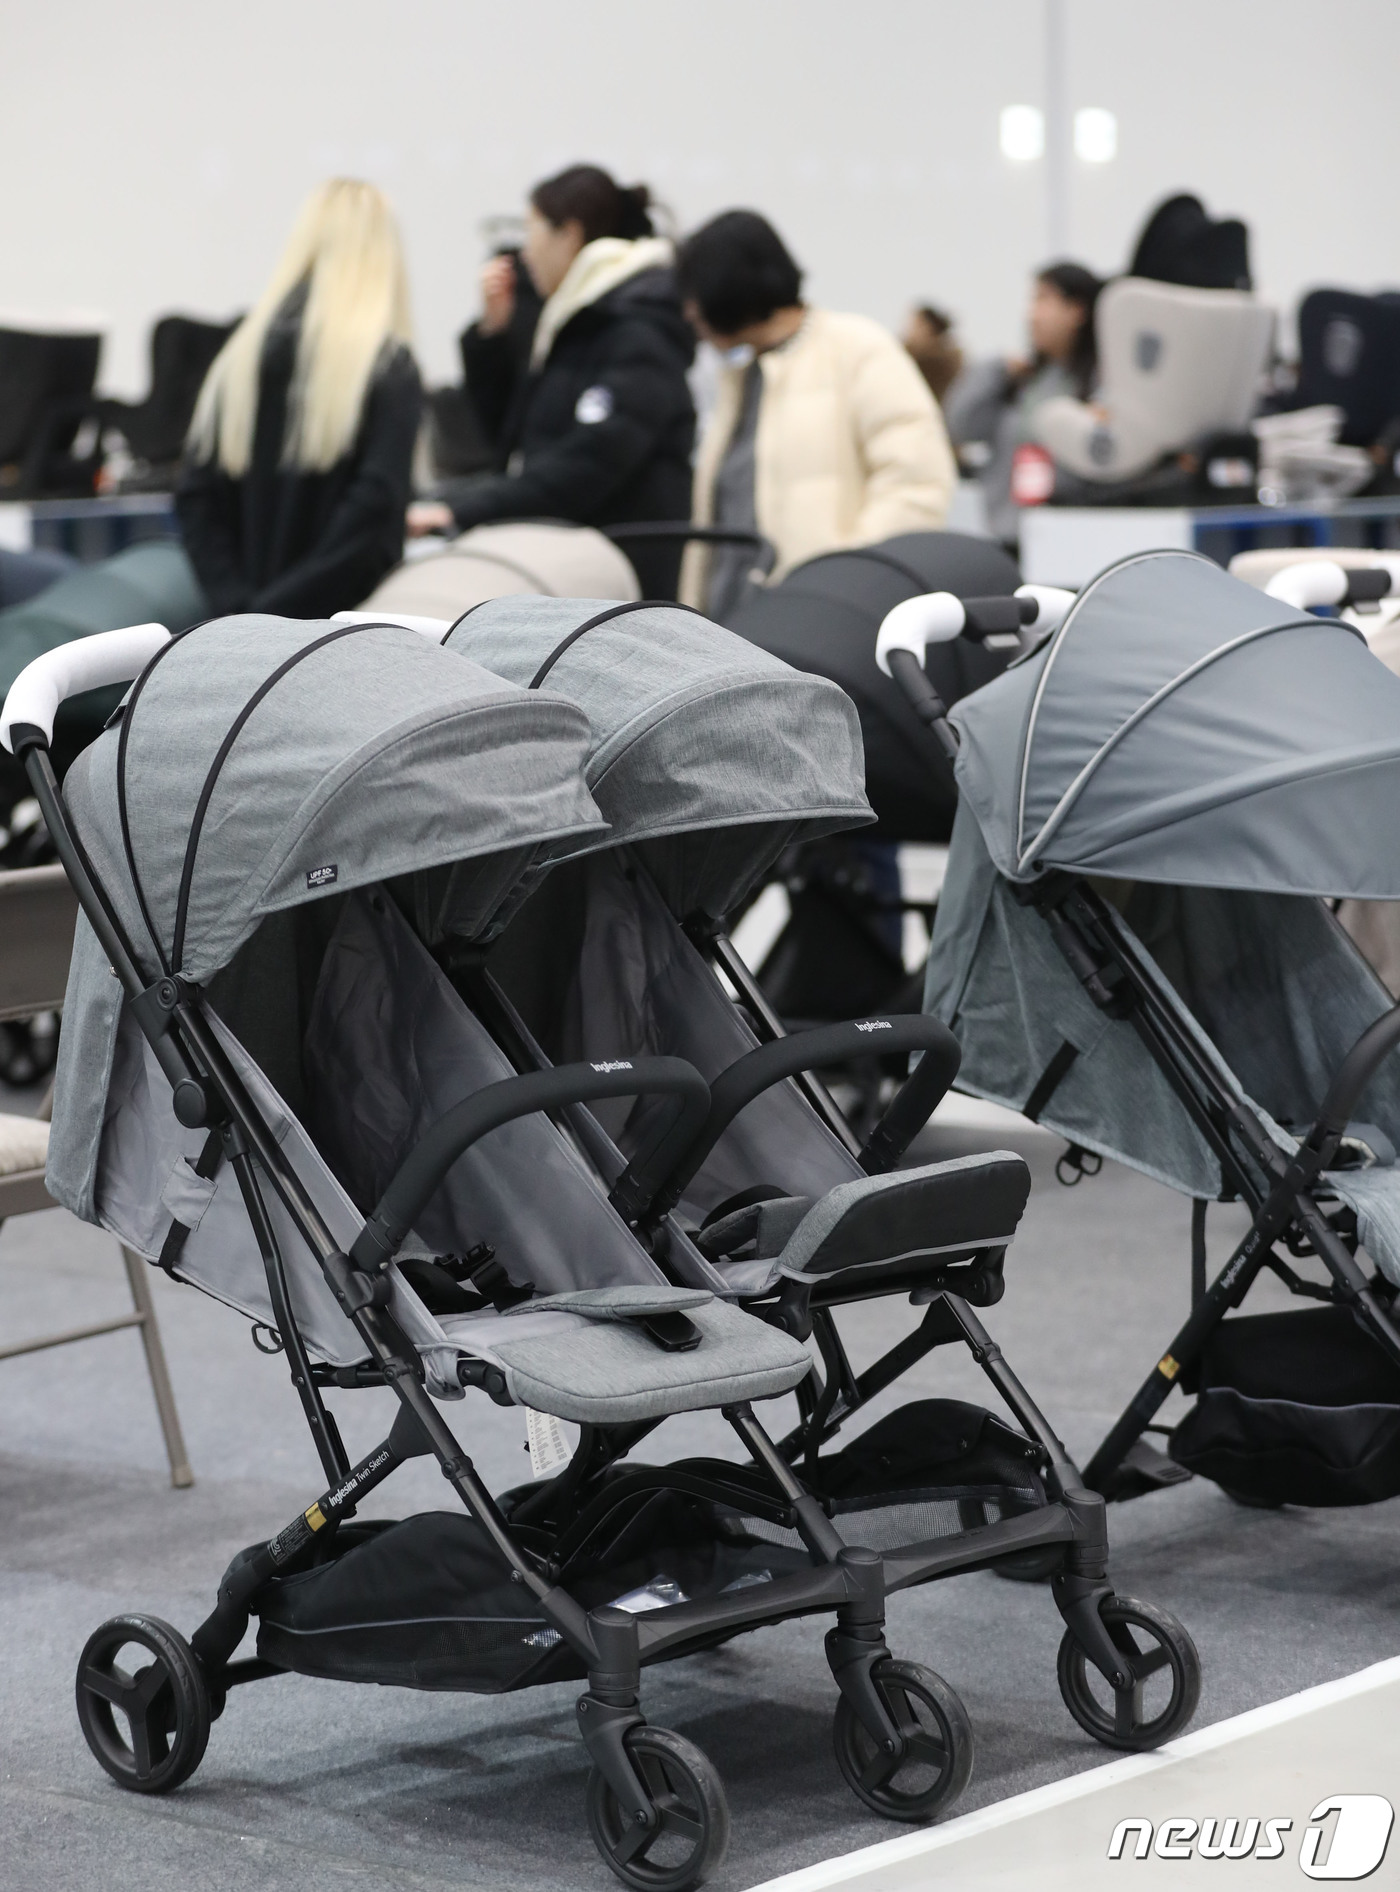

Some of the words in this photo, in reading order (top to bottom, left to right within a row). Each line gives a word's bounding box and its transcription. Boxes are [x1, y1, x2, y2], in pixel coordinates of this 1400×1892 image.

[854, 1020, 893, 1033] Inglesina
[589, 1060, 634, 1073] Inglesina
[328, 1478, 358, 1507] Inglesina
[355, 1468, 371, 1482] Twin
[368, 1450, 390, 1472] Sketch
